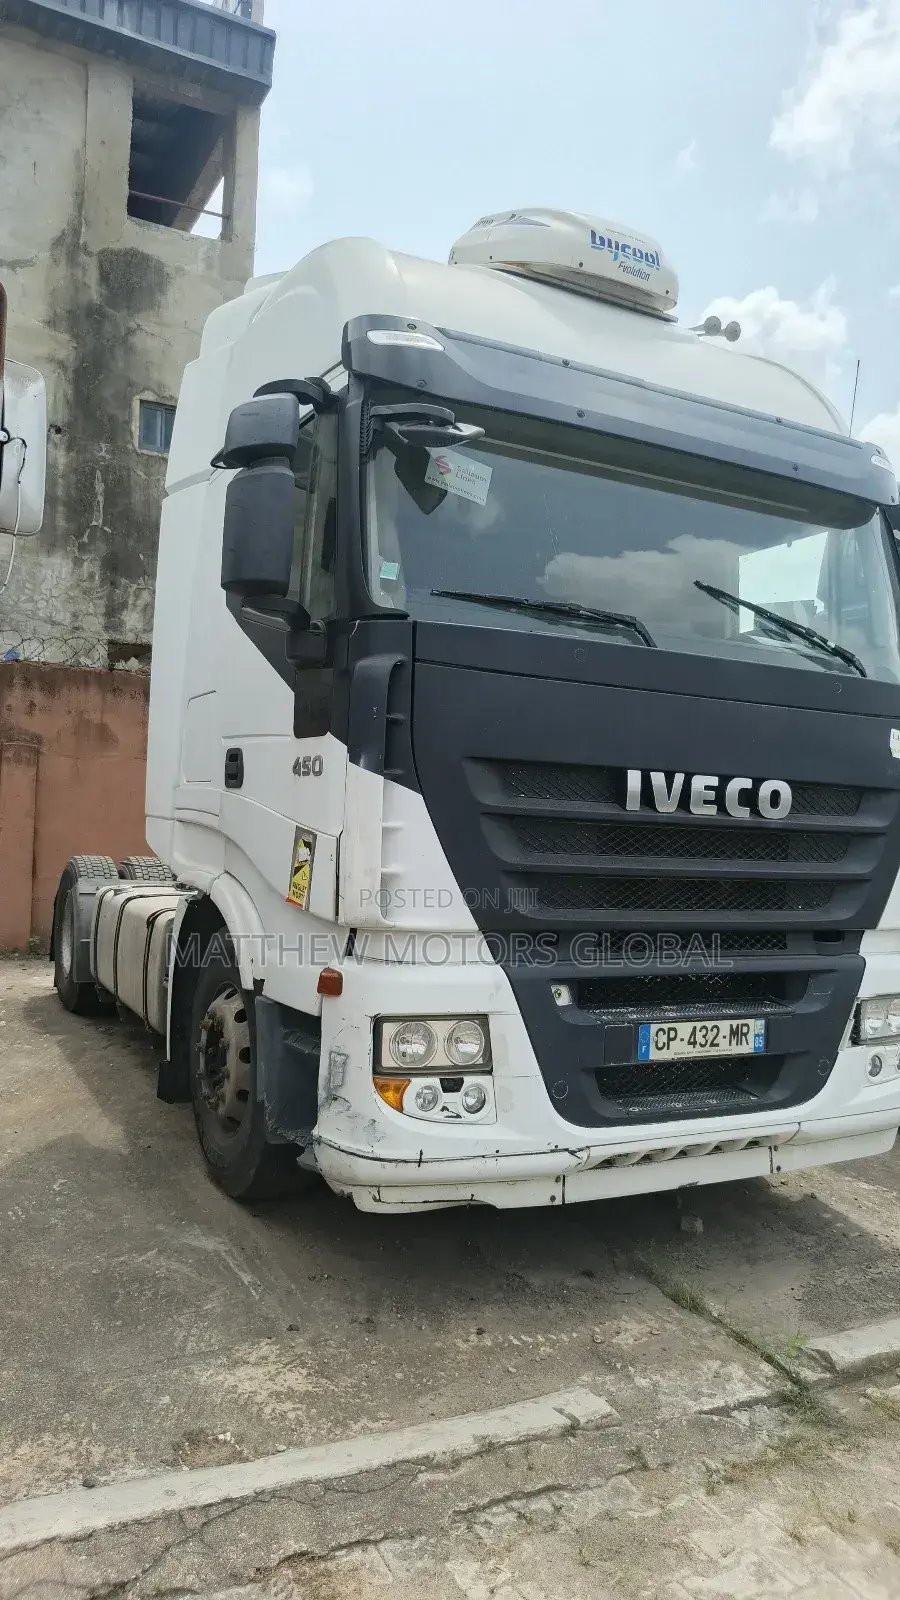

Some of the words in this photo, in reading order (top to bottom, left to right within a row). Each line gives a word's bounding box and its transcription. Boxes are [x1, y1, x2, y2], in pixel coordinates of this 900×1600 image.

[590, 229, 660, 271] bycool
[292, 754, 324, 777] 450
[625, 769, 793, 819] IVECO
[654, 1022, 750, 1051] CP-432-MR
